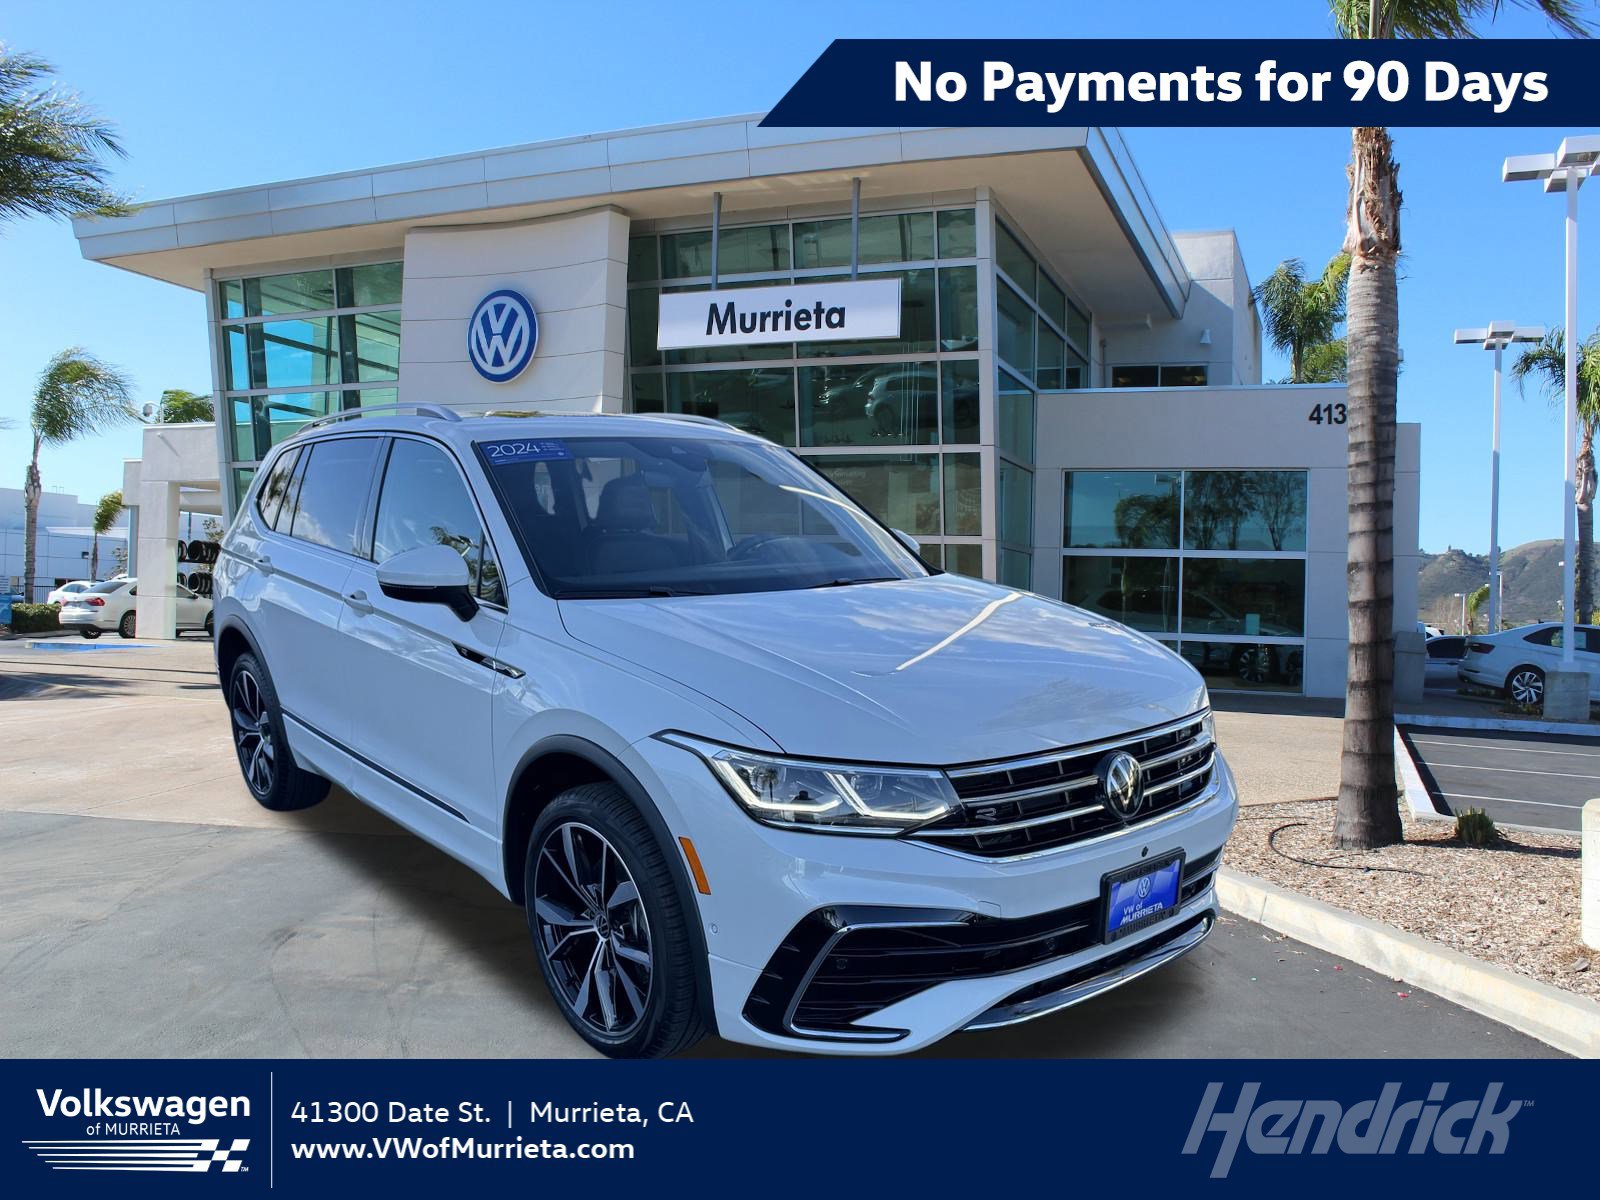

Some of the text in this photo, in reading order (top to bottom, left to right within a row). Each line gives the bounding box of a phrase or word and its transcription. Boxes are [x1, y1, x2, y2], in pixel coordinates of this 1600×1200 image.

[706, 299, 846, 336] Murrieta
[487, 442, 541, 457] 2024
[1120, 901, 1164, 926] MURRIETA
